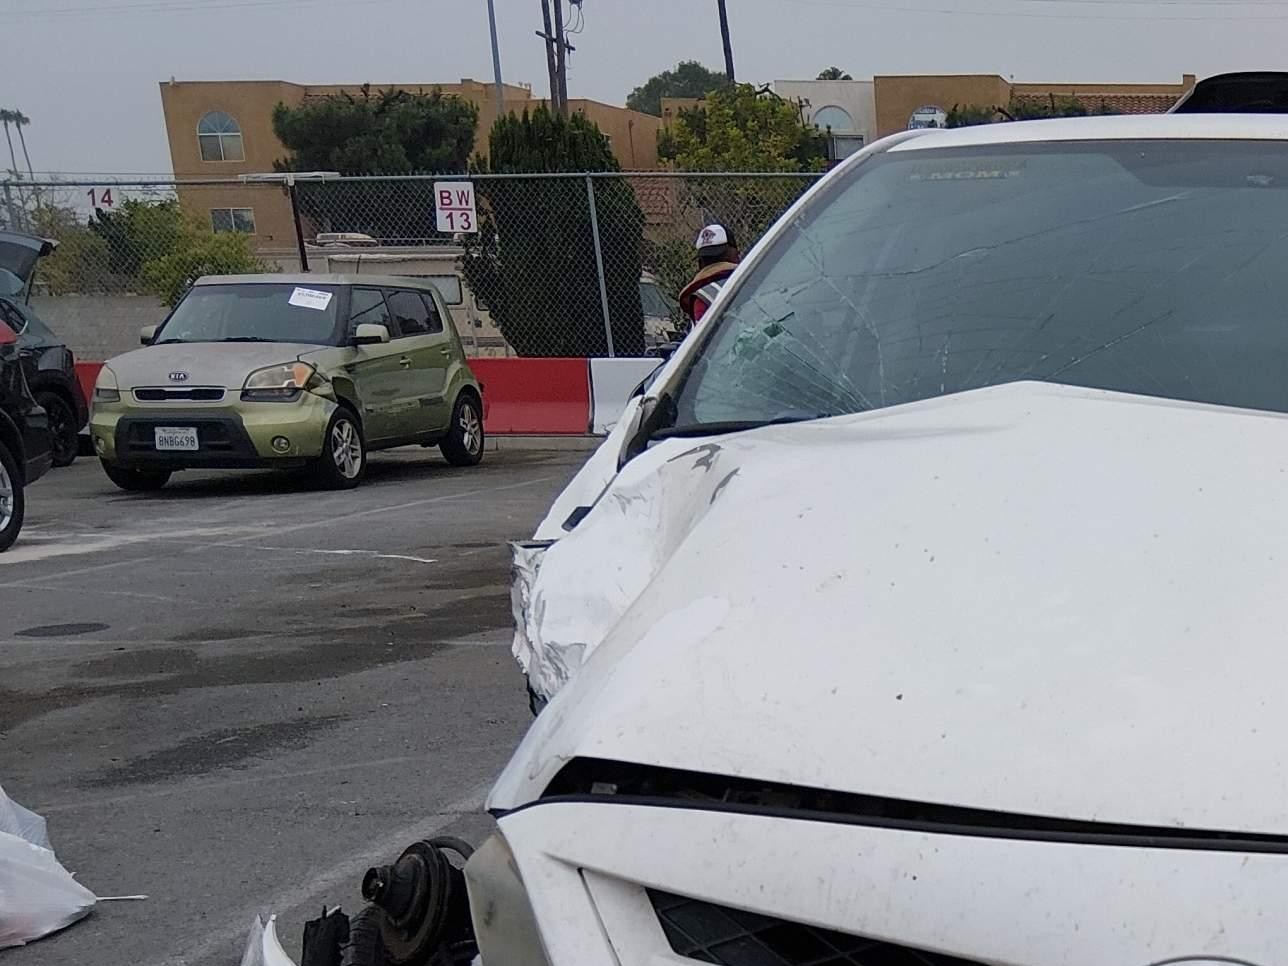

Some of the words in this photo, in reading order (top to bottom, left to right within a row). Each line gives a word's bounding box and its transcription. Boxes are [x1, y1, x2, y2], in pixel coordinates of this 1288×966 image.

[87, 188, 114, 207] 14
[440, 190, 470, 206] BW
[446, 212, 471, 230] 13
[158, 435, 196, 447] 8NBG698
